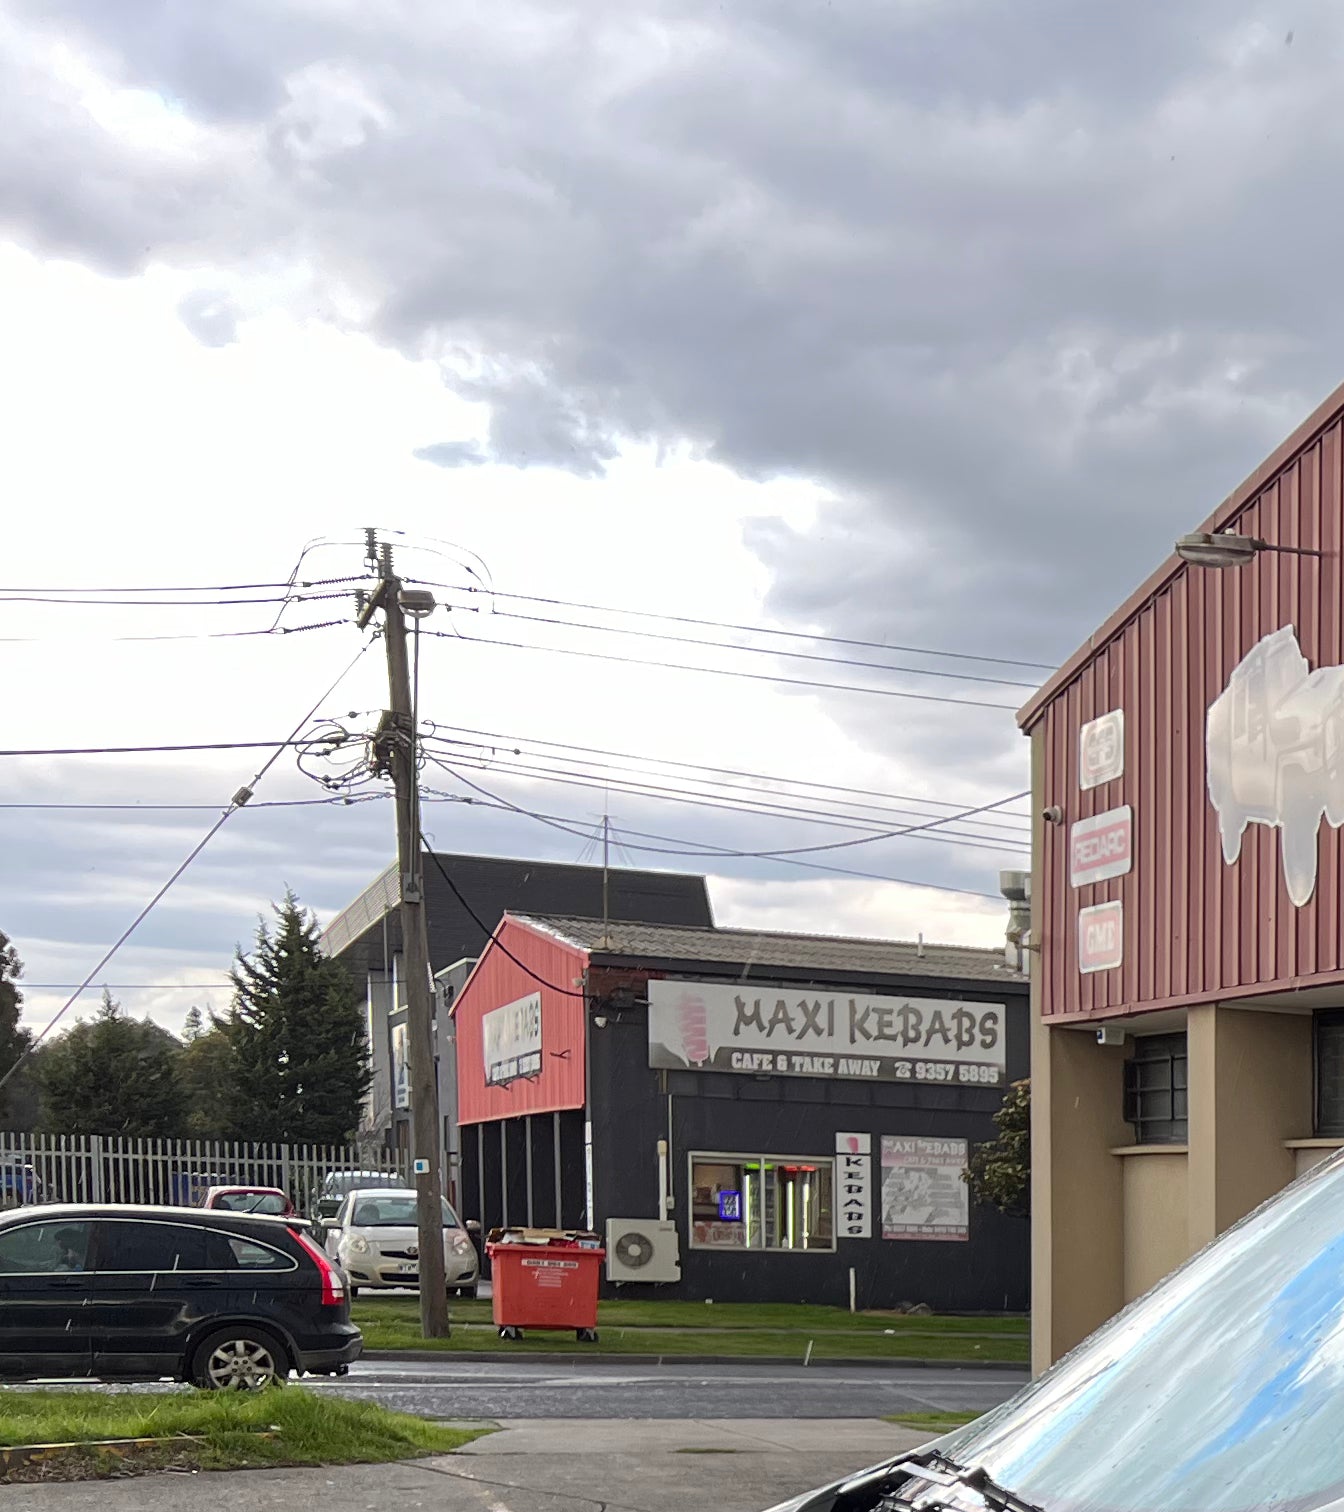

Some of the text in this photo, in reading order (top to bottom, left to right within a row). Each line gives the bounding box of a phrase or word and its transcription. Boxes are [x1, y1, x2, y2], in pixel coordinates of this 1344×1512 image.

[1074, 828, 1126, 867] REDARC
[733, 994, 999, 1051] MAXI KEBABS
[731, 1052, 999, 1084] CAFE & TAKE AWAY 9357 5895
[843, 1156, 863, 1235] KEBABS
